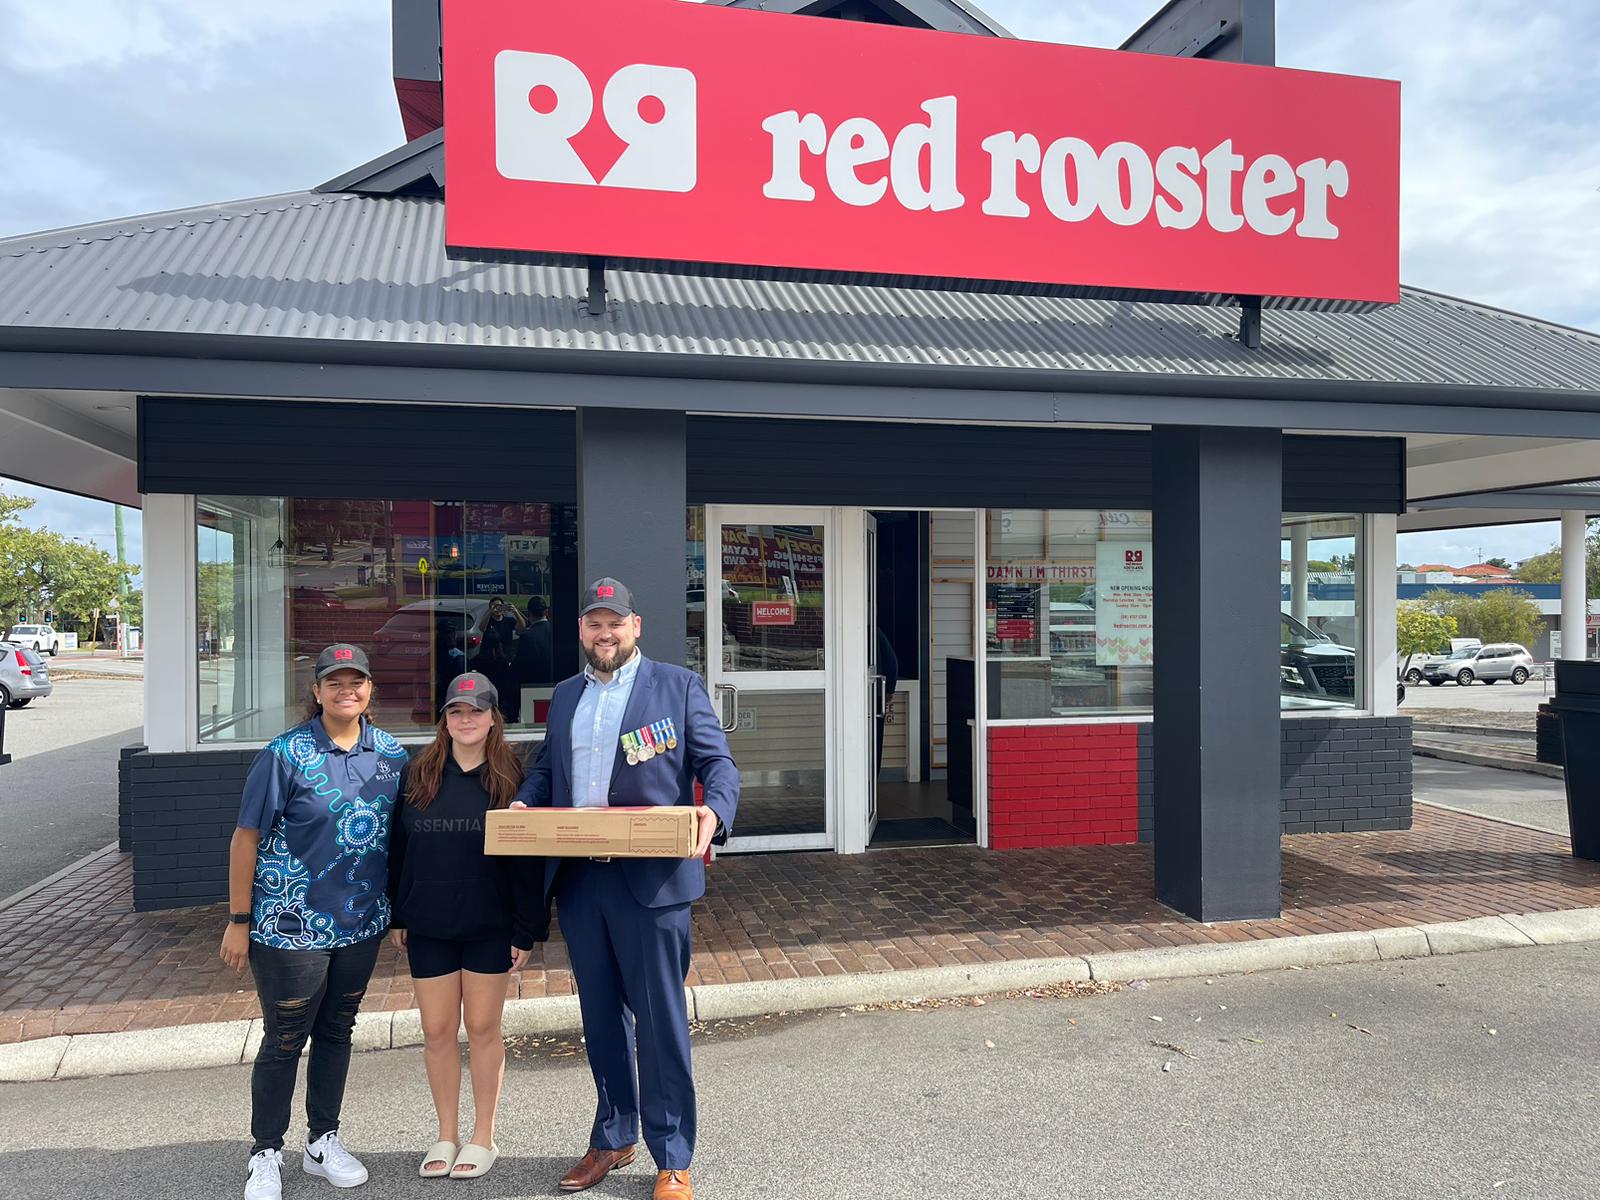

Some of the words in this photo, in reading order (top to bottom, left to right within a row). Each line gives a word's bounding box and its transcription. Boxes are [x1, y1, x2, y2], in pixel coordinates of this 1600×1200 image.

[762, 96, 965, 211] red
[982, 131, 1350, 240] rooster
[987, 566, 1023, 578] DAMN
[756, 607, 790, 616] WELCOME
[414, 818, 482, 832] SSENTIA
